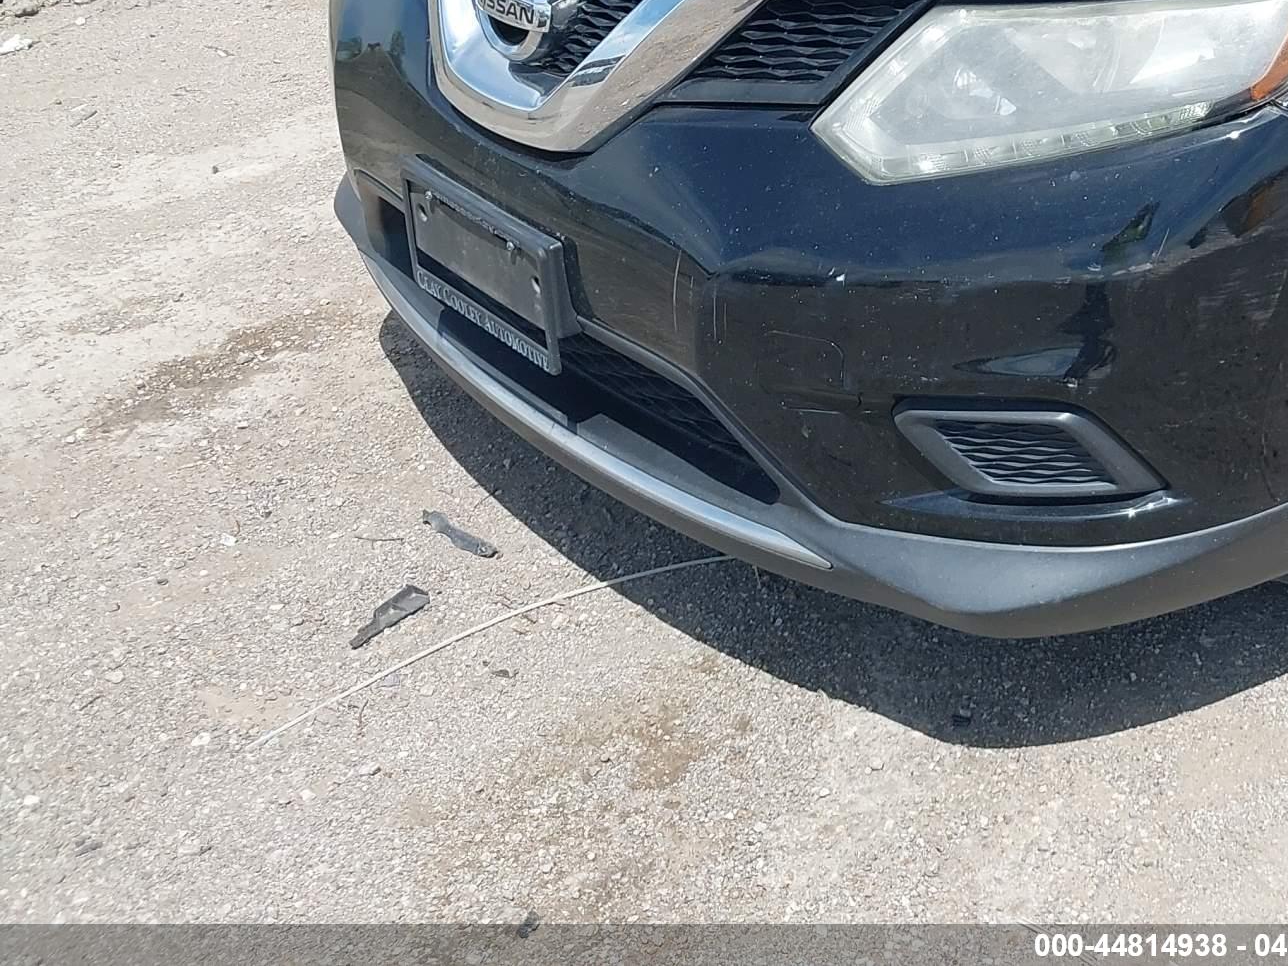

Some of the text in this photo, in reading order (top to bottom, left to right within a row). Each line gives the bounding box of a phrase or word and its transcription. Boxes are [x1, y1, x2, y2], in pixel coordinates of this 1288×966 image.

[416, 270, 550, 372] CLAY COOLEY AUTOMOTIVE
